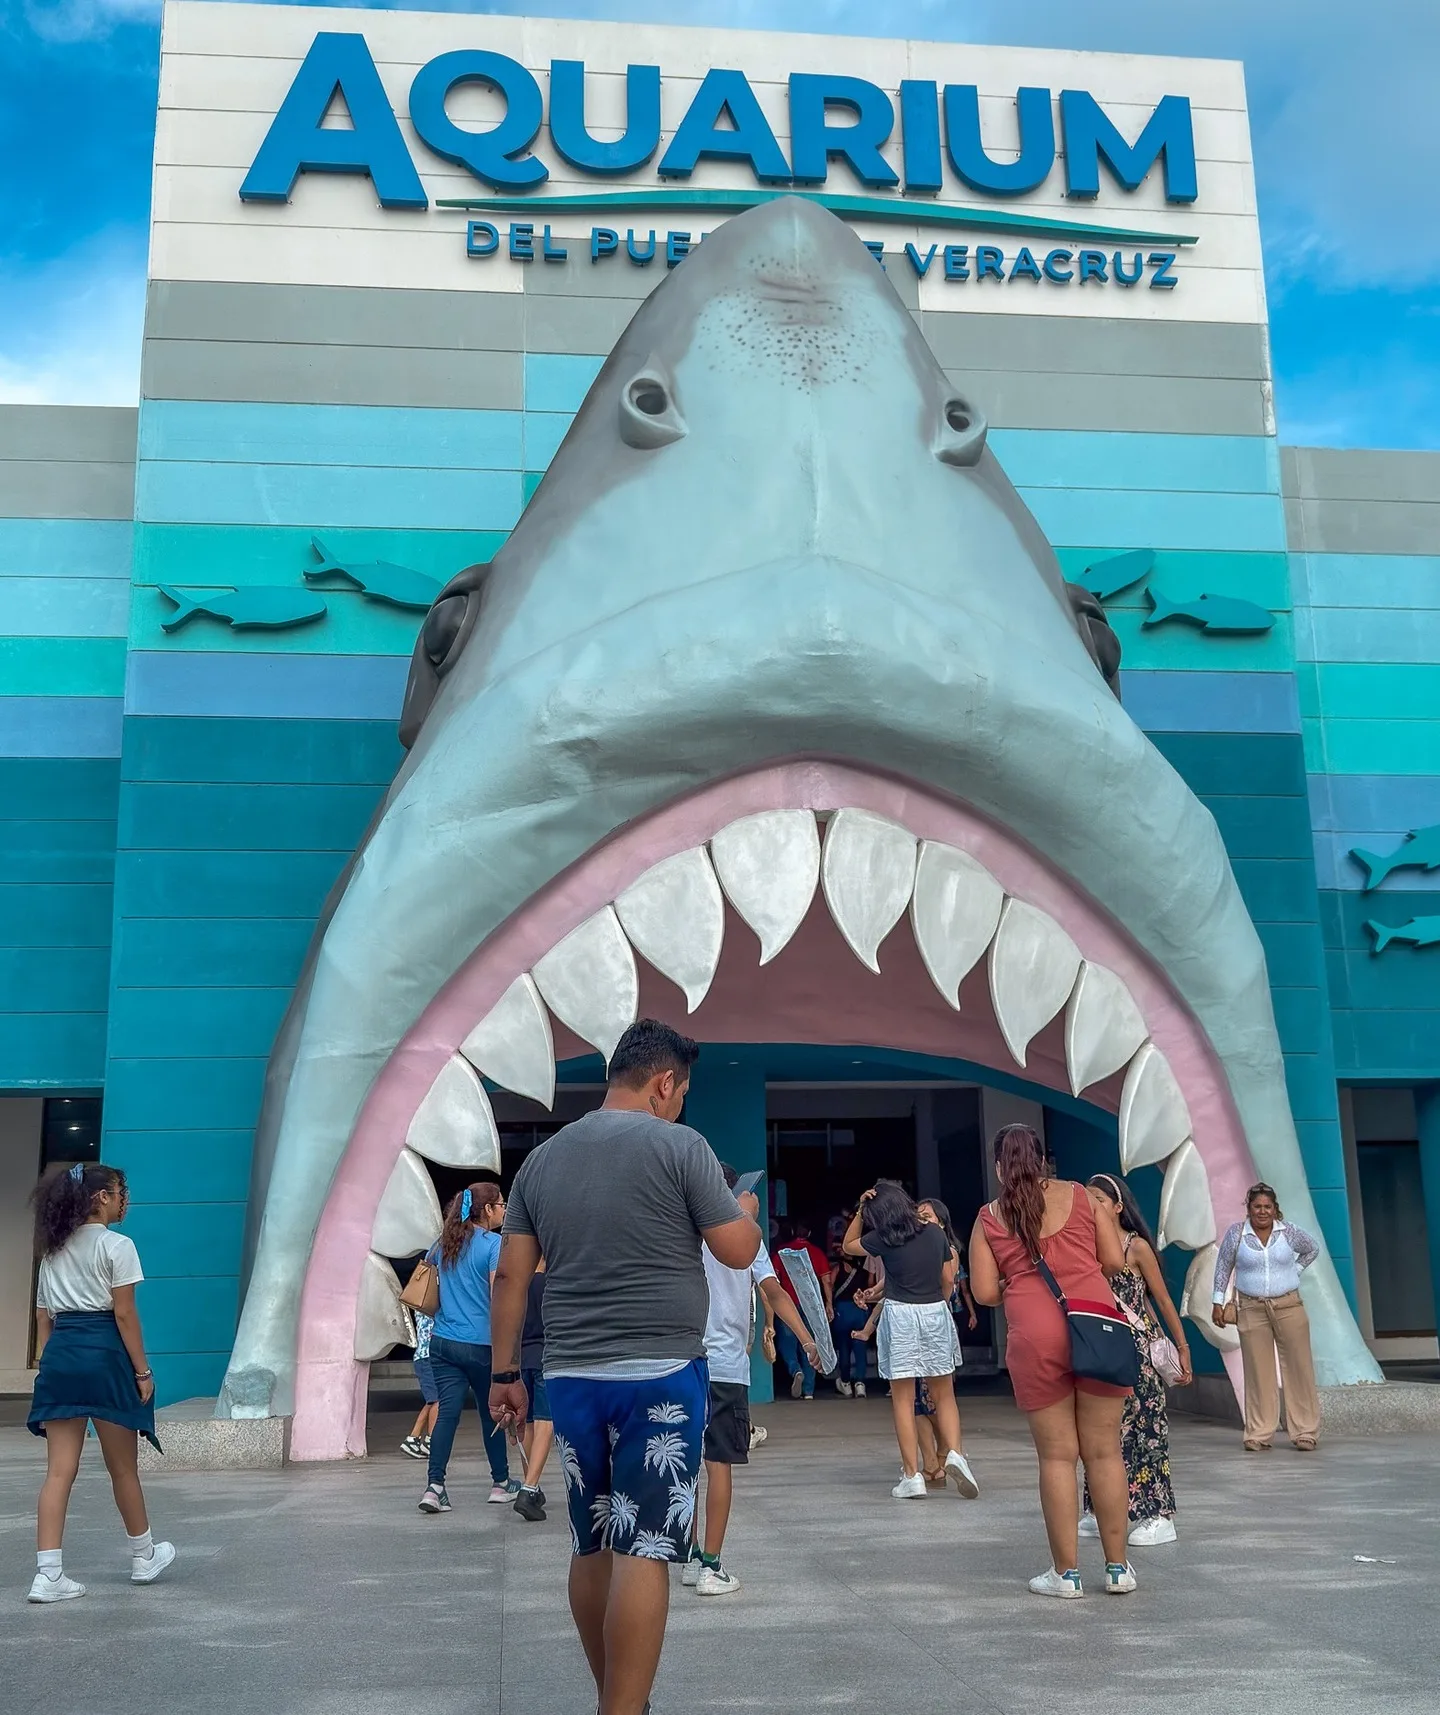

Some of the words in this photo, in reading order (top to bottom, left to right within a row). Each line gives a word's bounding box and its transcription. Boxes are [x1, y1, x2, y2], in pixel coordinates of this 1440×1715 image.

[239, 31, 1198, 208] AQUARIUM
[467, 220, 568, 261] DEL
[591, 227, 711, 268] PUE
[904, 242, 1179, 289] VERACRUZ
